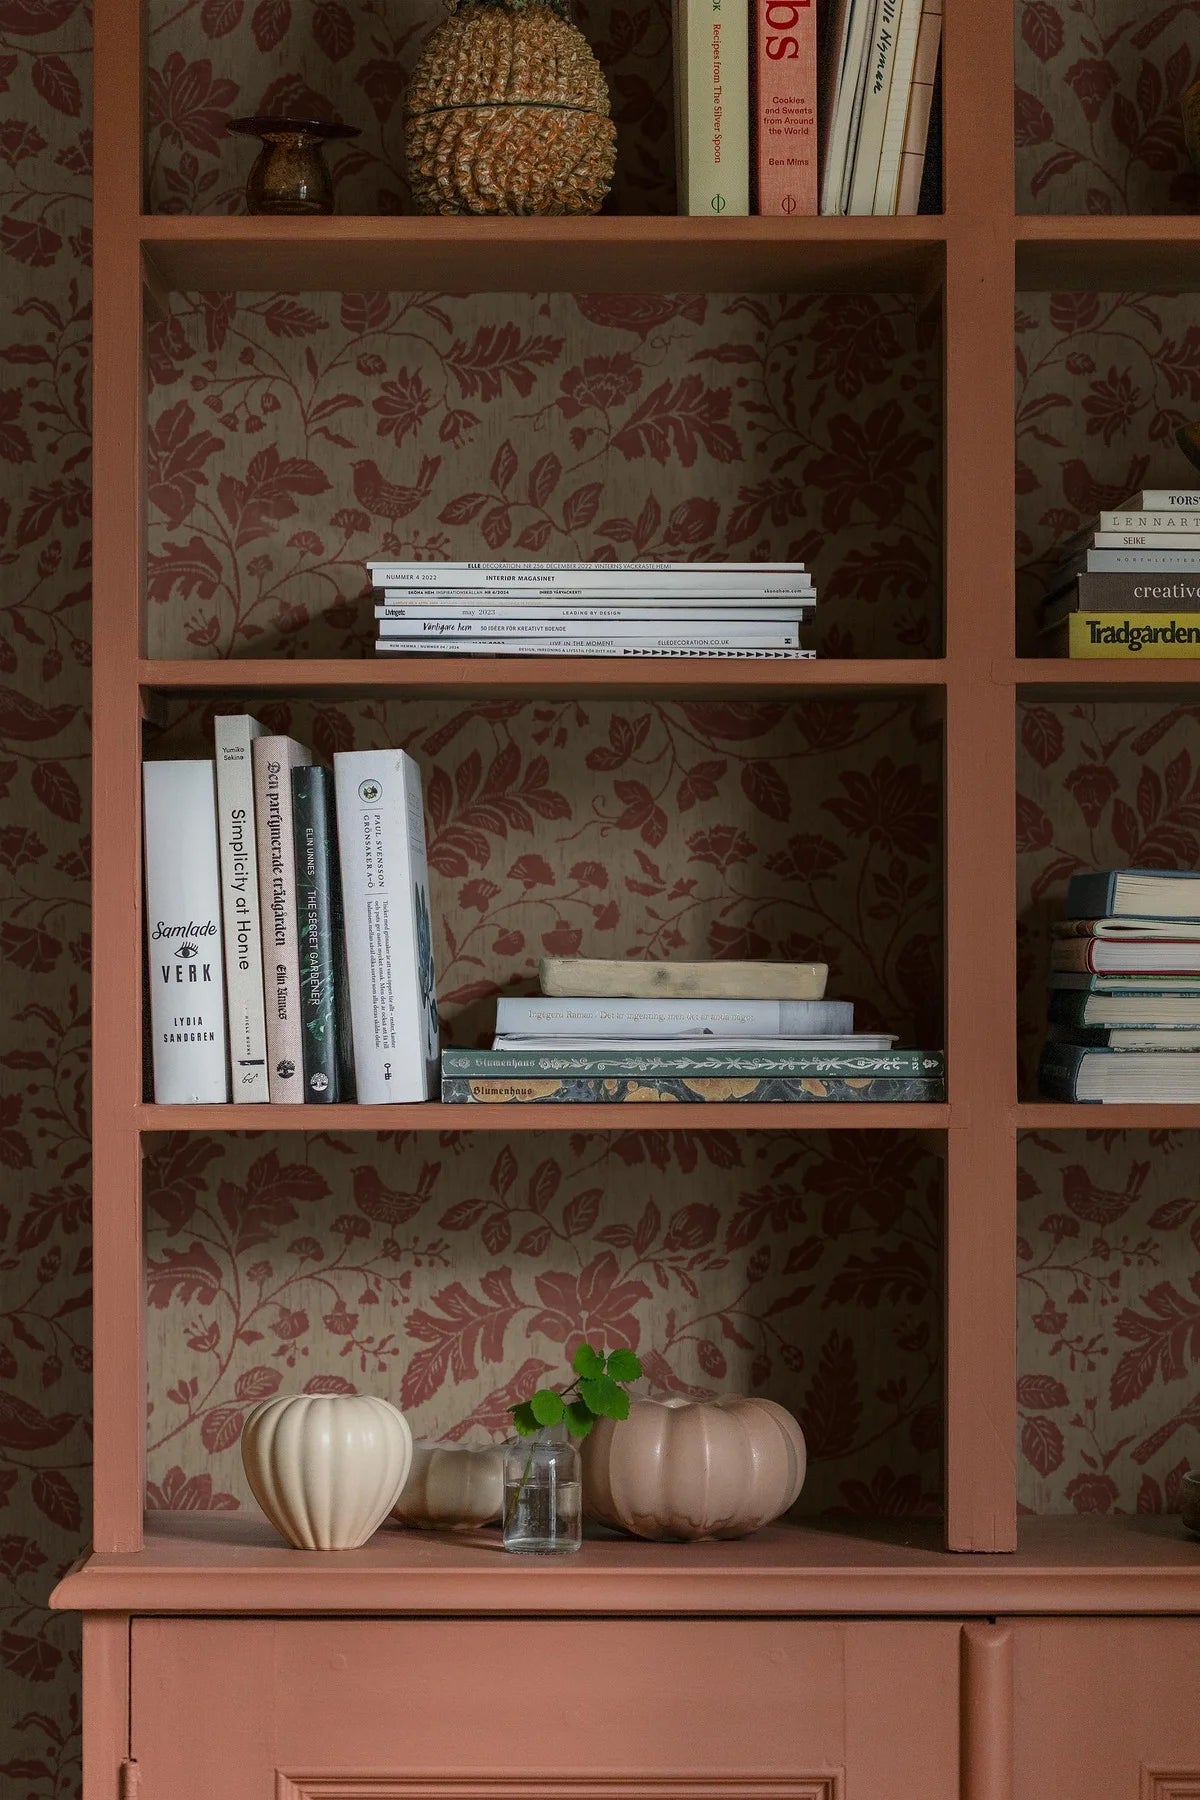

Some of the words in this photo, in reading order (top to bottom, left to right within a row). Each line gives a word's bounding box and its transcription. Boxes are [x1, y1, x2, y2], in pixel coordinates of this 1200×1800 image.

[712, 24, 721, 60] Recipes
[713, 62, 722, 83] from
[714, 86, 722, 104] The
[713, 106, 722, 132] Silver
[784, 116, 814, 124] Around
[712, 134, 722, 164] Spoon
[1168, 496, 1200, 505] TORS
[1112, 517, 1200, 527] LENNART
[458, 622, 472, 631] hem
[267, 761, 281, 790] Den
[266, 792, 284, 875] parfymerade
[306, 828, 314, 846] ELIN
[363, 814, 373, 869] GRÖNSAKER
[229, 810, 248, 892] Simplicity
[306, 848, 315, 876] UNNES
[376, 841, 385, 888] SVENSSON
[236, 897, 249, 914] at
[307, 890, 317, 910] THE
[271, 878, 288, 947] trädgården
[152, 920, 217, 940] Samlade
[308, 912, 318, 949] SECRET
[236, 920, 251, 970] Home
[162, 964, 212, 983] VERK
[276, 964, 288, 985] Elin
[310, 952, 320, 1006] GARDENER
[174, 1016, 203, 1027] LYDIA
[164, 1032, 215, 1043] SANDGREN
[475, 1058, 535, 1068] Blumenhaus
[474, 1086, 532, 1097] Blumenhaus
